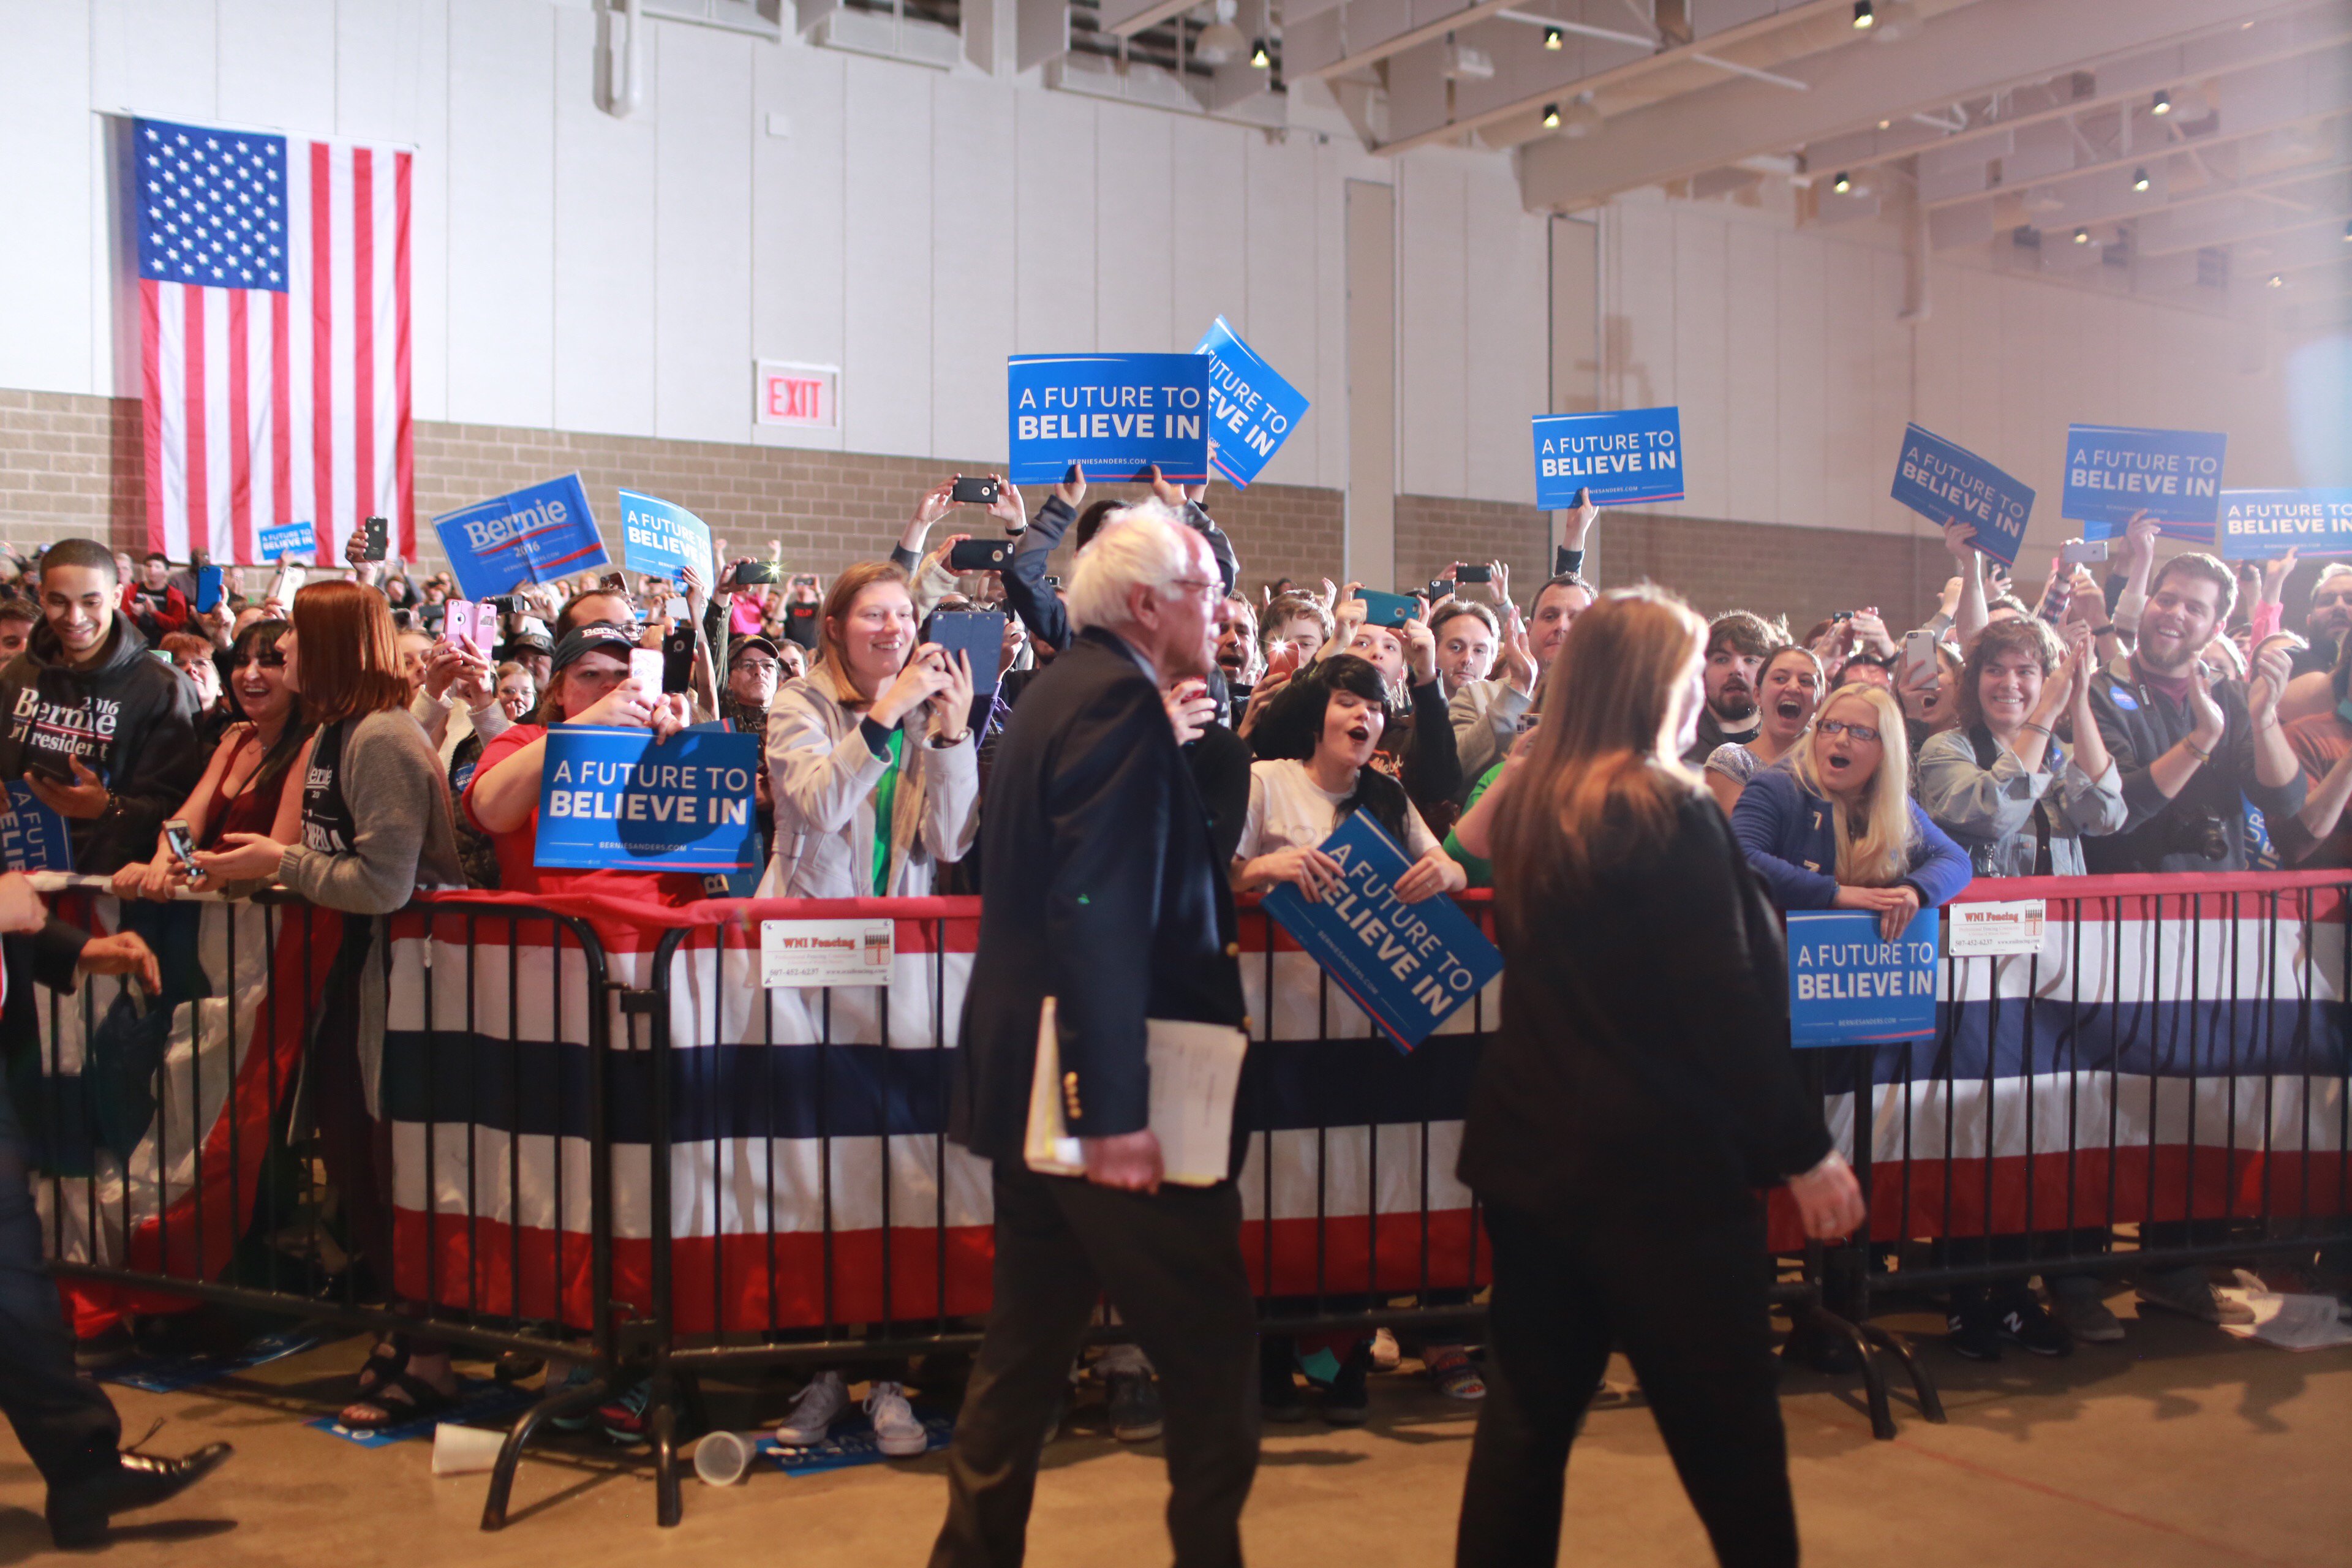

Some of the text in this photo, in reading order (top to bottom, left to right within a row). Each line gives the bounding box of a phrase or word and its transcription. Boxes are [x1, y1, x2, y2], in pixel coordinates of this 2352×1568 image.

[768, 377, 822, 419] EXIT
[1019, 386, 1200, 409] A FUTURE TO
[1195, 343, 1208, 355] A
[1262, 403, 1287, 434] TO
[1019, 414, 1199, 440] BELIEVE IN
[1245, 424, 1275, 458] IN
[1542, 430, 1674, 454] A FUTURE TO
[1542, 450, 1676, 477] BELIEVE IN
[2073, 448, 2217, 474] A FUTURE TO
[1580, 486, 1638, 494] NIESANDERS.COM
[1907, 447, 2024, 519] A FUTURE TO
[2071, 468, 2215, 497] BELIEVE IN
[1902, 461, 2020, 538] BELIEVE IN
[2228, 503, 2352, 518] A FUTURE TO
[268, 530, 299, 540] FUTURE
[463, 499, 567, 548] Bernie
[628, 510, 709, 550] A FUTURE TO
[2229, 518, 2325, 535] BELIEVE
[263, 535, 314, 551] BELIEVE IN
[513, 540, 540, 558] 2016
[628, 526, 699, 564] BELIEVE
[554, 760, 748, 791] A FUTURE TO
[12, 792, 32, 807] A
[549, 790, 747, 826] BELIEVE IN
[599, 842, 687, 852] BERNIESANDERS.COM
[1329, 843, 1472, 992] A FUTURE TO
[1965, 911, 2019, 923] WNI Fencing
[783, 936, 856, 949] WNI Fencing
[1797, 942, 1934, 967] A FUTURE TO
[1317, 930, 1379, 995] BERNIESANDERS.COM
[1411, 974, 1453, 1017] IN
[1798, 970, 1932, 1000] BELIEVE IN
[1839, 1017, 1896, 1026] BERNIESANDERS.COM
